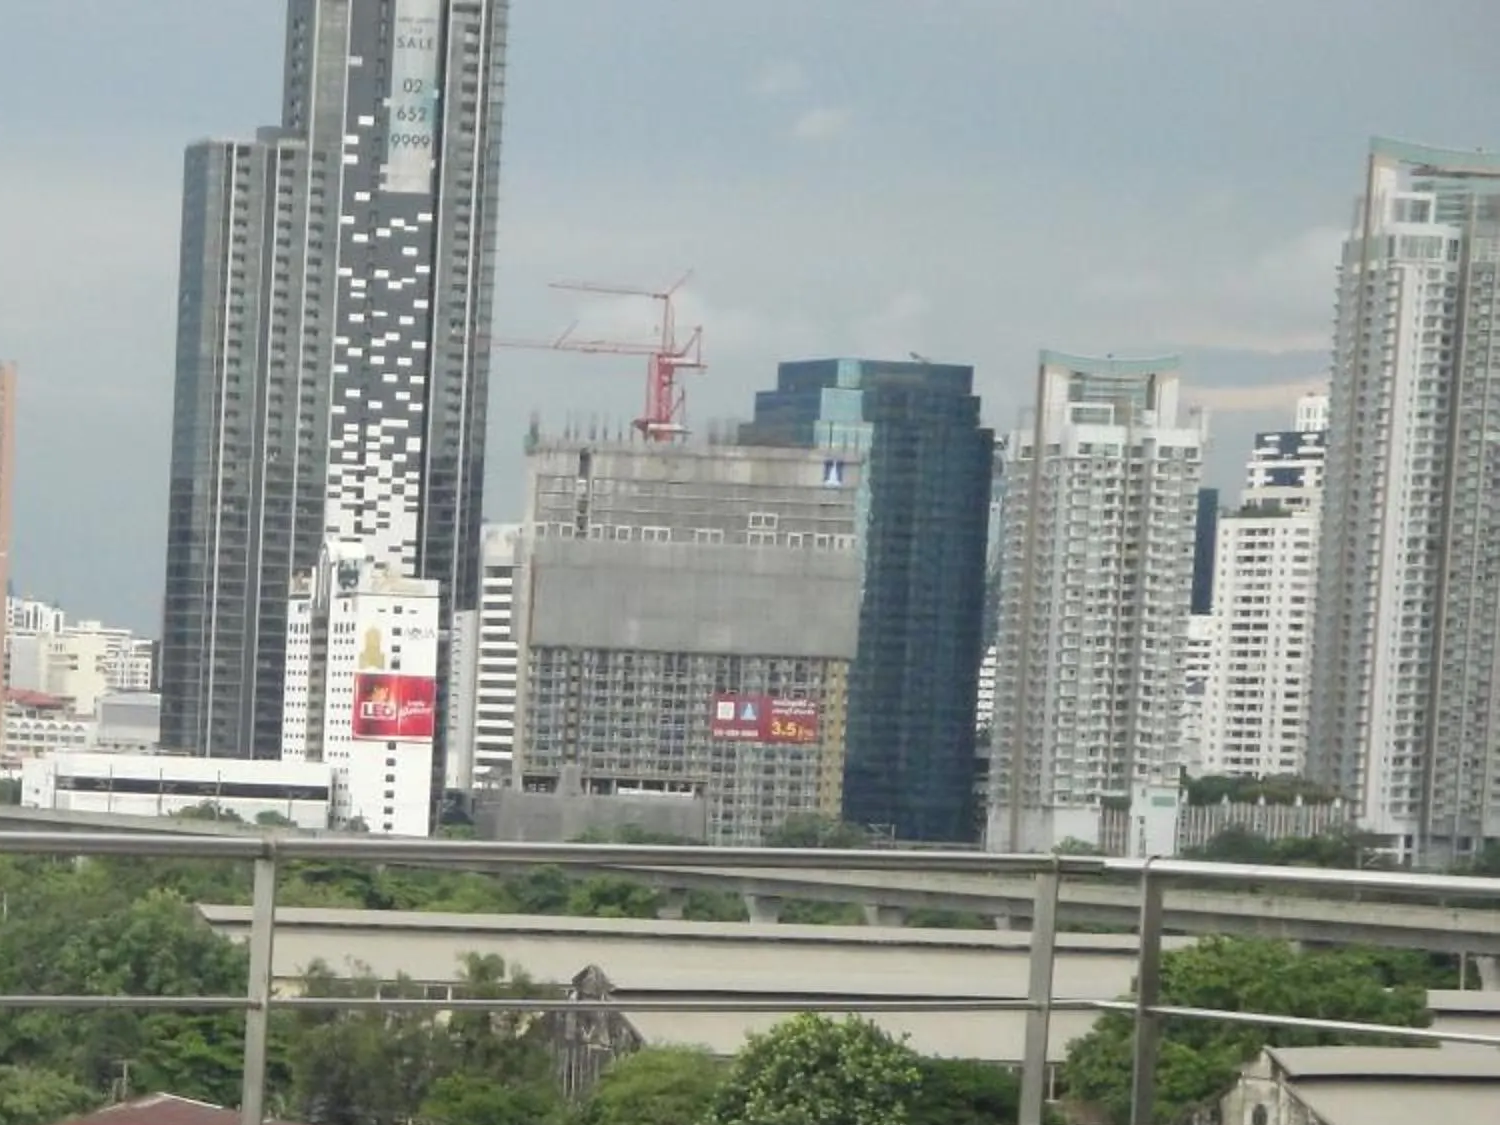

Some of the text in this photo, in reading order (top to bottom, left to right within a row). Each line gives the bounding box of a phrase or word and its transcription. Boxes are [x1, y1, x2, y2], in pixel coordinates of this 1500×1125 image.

[396, 37, 434, 50] SALE
[403, 78, 423, 93] 02
[397, 107, 427, 122] 652
[390, 133, 431, 149] 9999
[363, 704, 394, 717] LEO
[771, 721, 797, 736] 3.5
